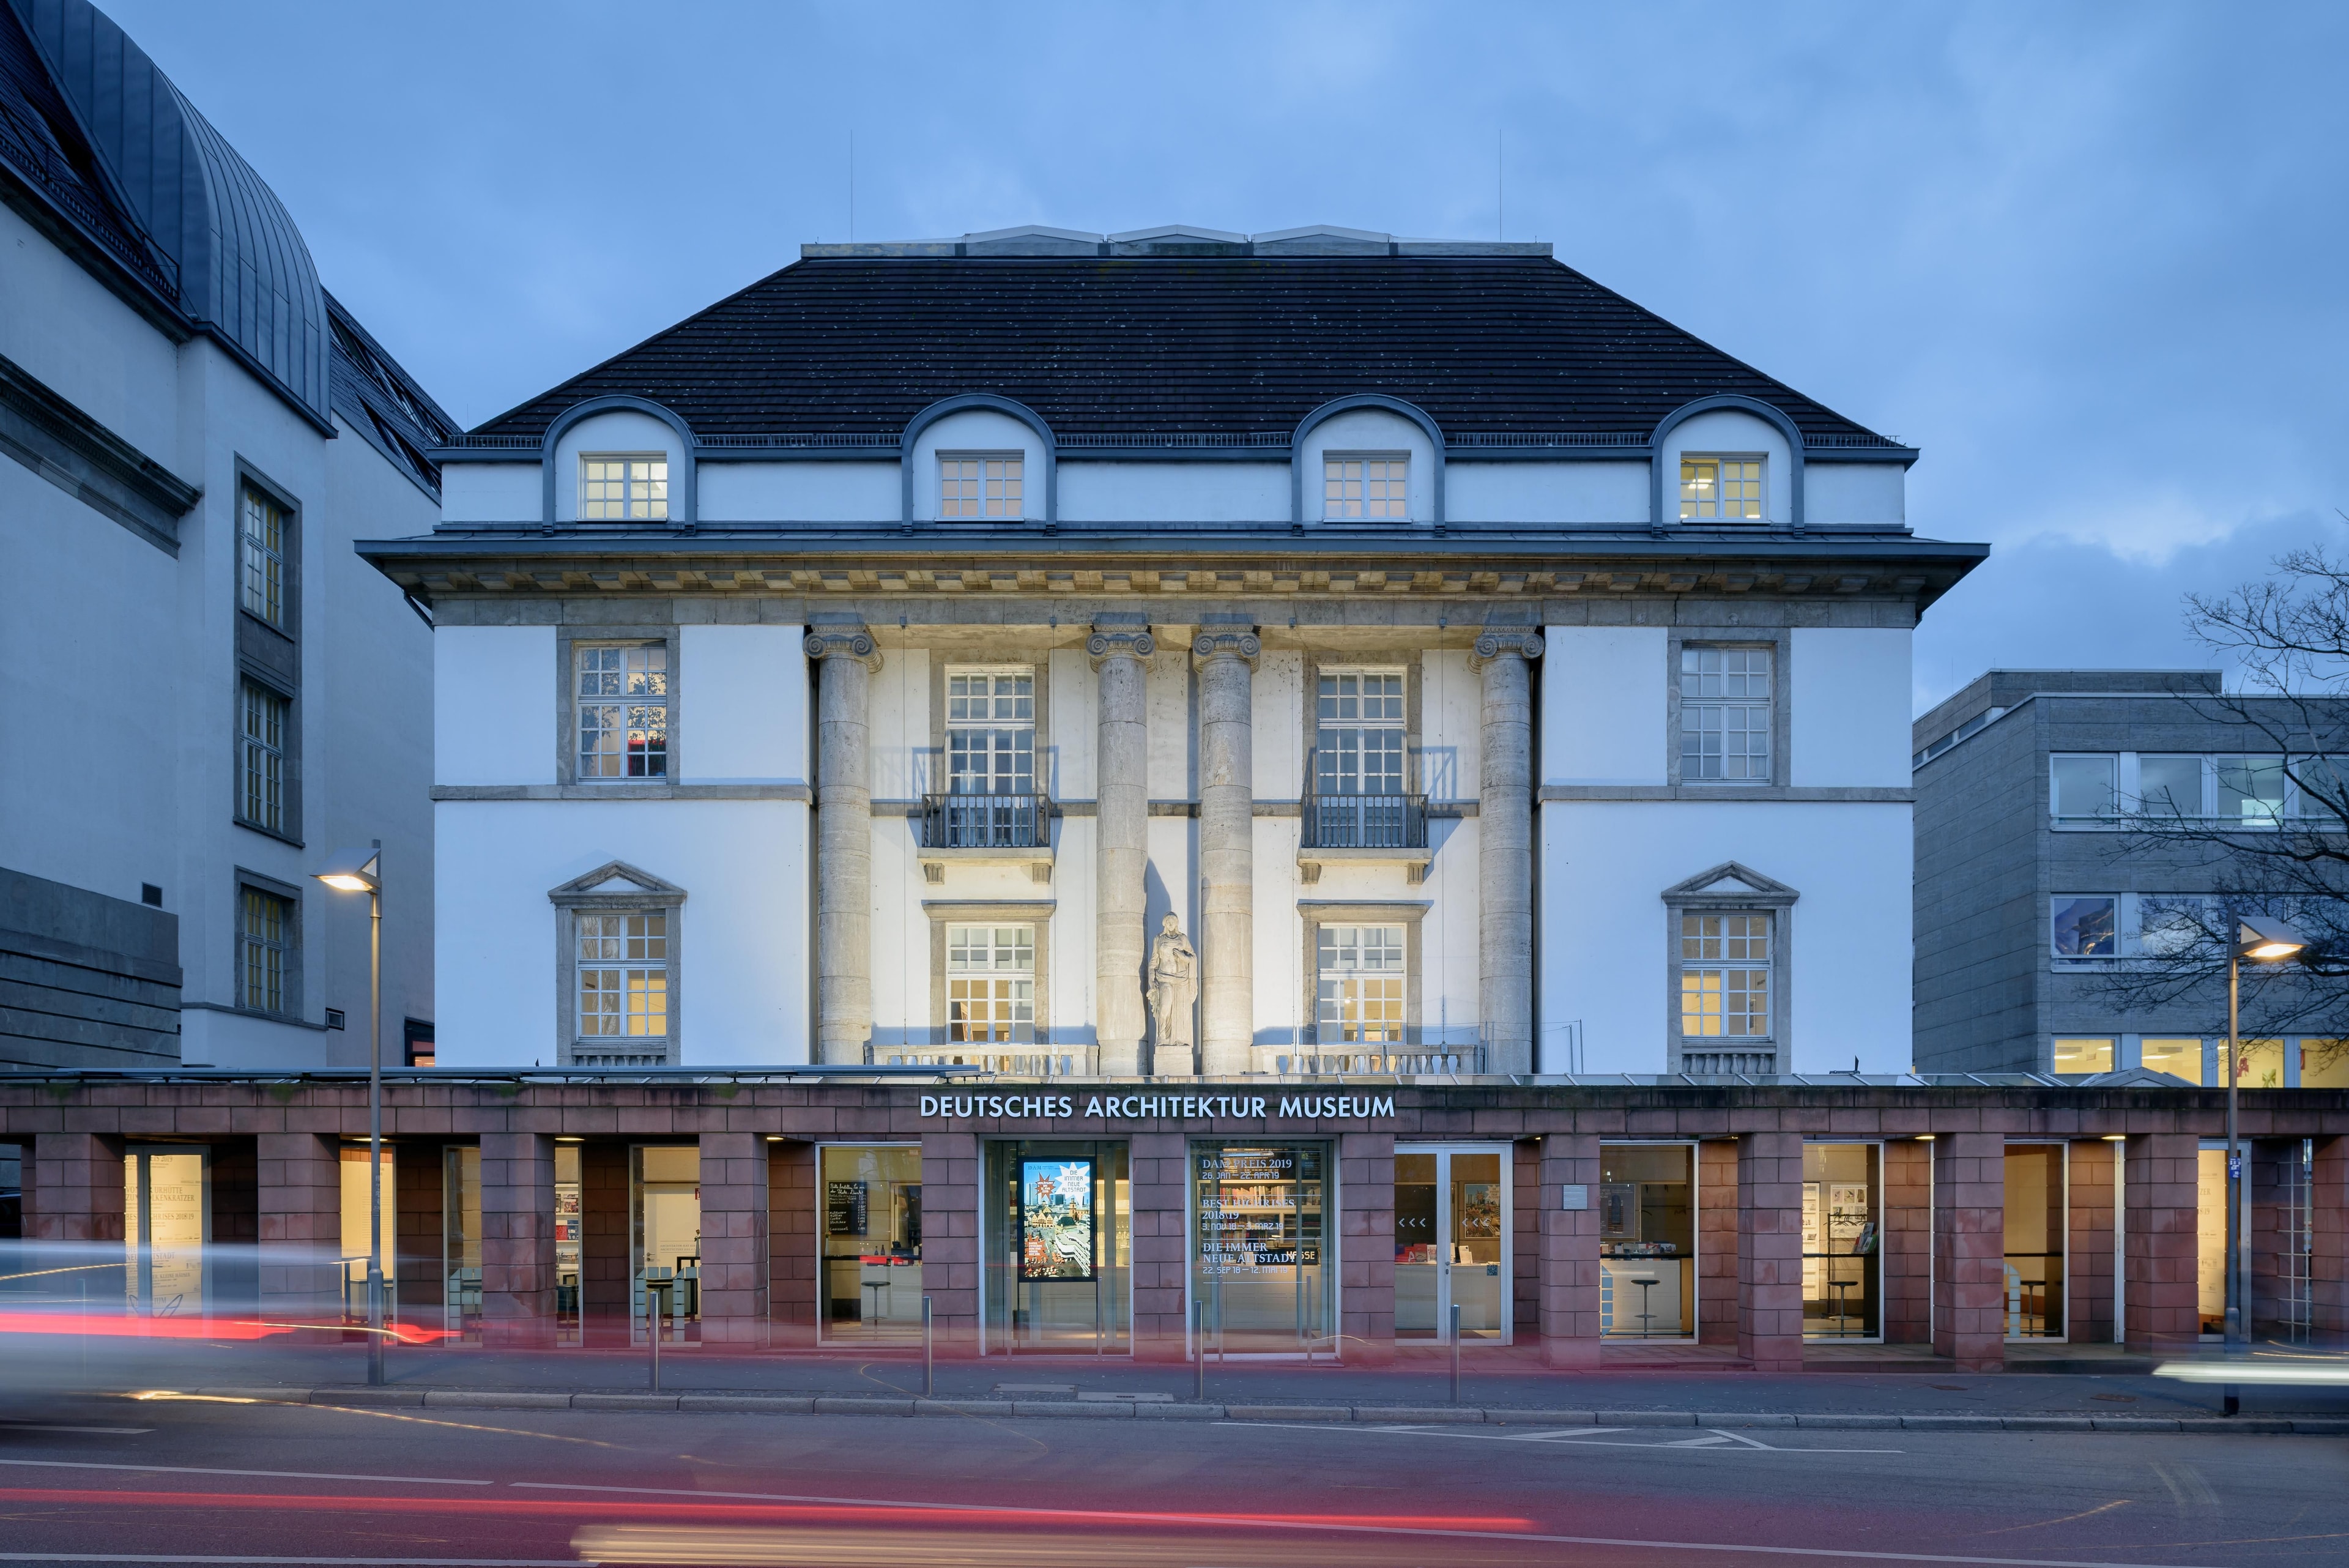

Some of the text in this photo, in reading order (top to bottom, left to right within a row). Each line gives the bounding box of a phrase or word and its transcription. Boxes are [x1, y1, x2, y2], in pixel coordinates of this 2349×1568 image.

[921, 1096, 1395, 1118] DEUTSCHES ARCHITEKTUR MUSEUM
[1203, 1159, 1230, 1169] DAM
[1233, 1159, 1266, 1169] PREIS
[1269, 1159, 1292, 1169] 2019
[1203, 1200, 1294, 1208] BEST HIGHRISES
[1202, 1211, 1239, 1219] 2018\19
[1203, 1243, 1267, 1252] DIE IMMER
[1203, 1254, 1296, 1263] NEUE ALTSTADT
